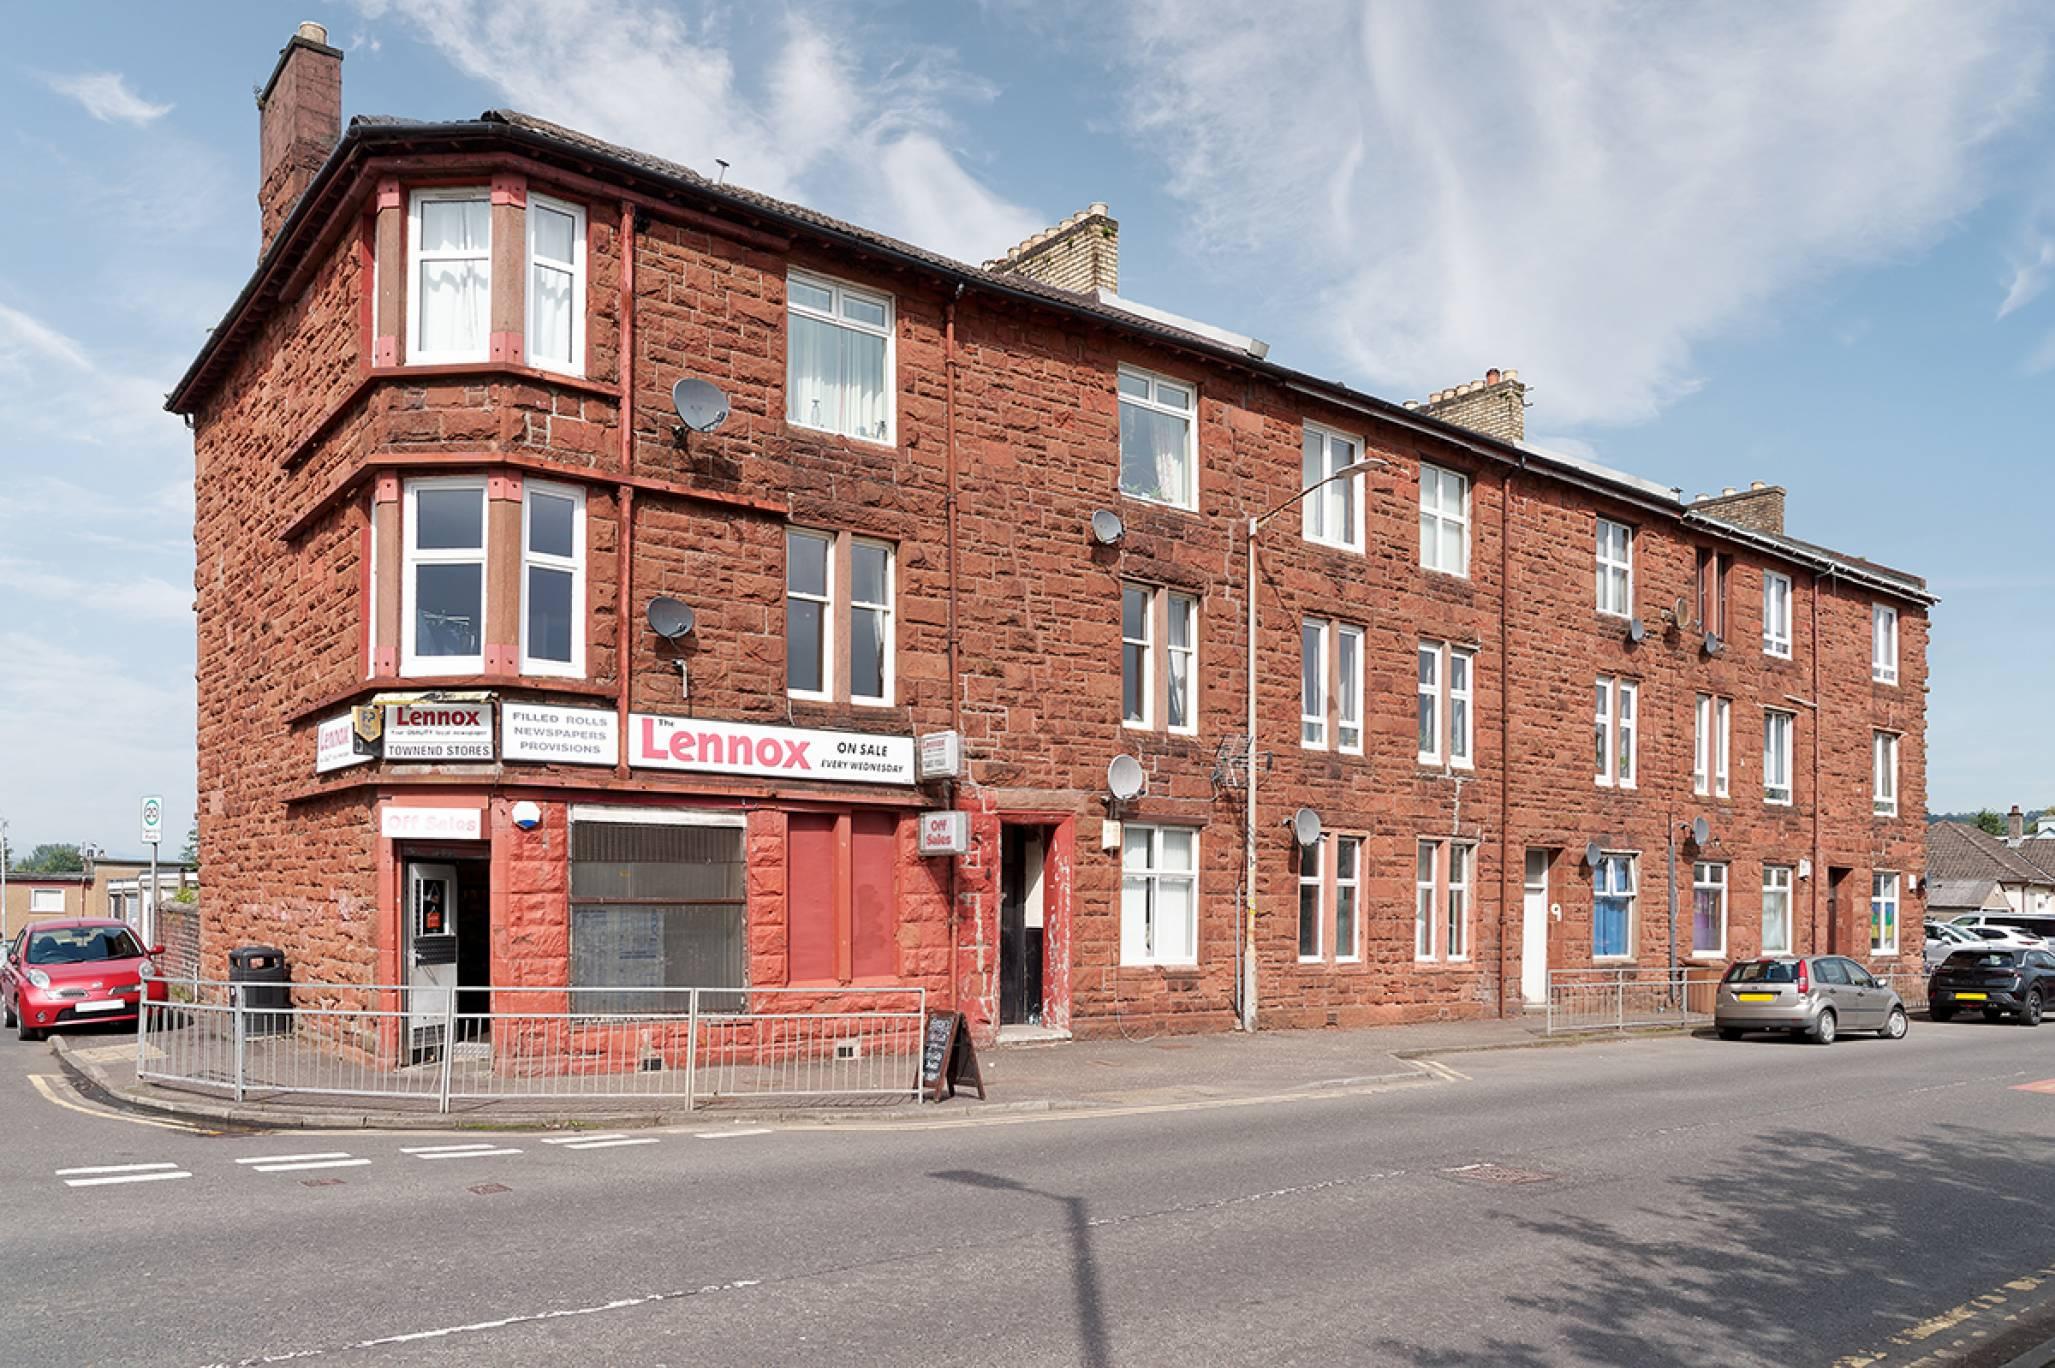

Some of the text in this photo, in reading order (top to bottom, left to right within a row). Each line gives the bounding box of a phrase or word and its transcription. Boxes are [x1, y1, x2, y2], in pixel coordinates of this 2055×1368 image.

[397, 707, 480, 726] Lennox
[513, 711, 608, 727] FILLED ROLLS
[514, 726, 607, 740] NEWSPAPERS
[389, 745, 490, 756] TOWNEND STORES
[520, 740, 601, 754] PROVISIONS
[642, 718, 811, 770] The Lennox
[837, 742, 888, 757] ON SALE
[821, 758, 904, 773] EVERY WEDNESDAY
[388, 815, 477, 832] Off Sales
[931, 819, 947, 832] Off
[926, 833, 952, 846] Sales
